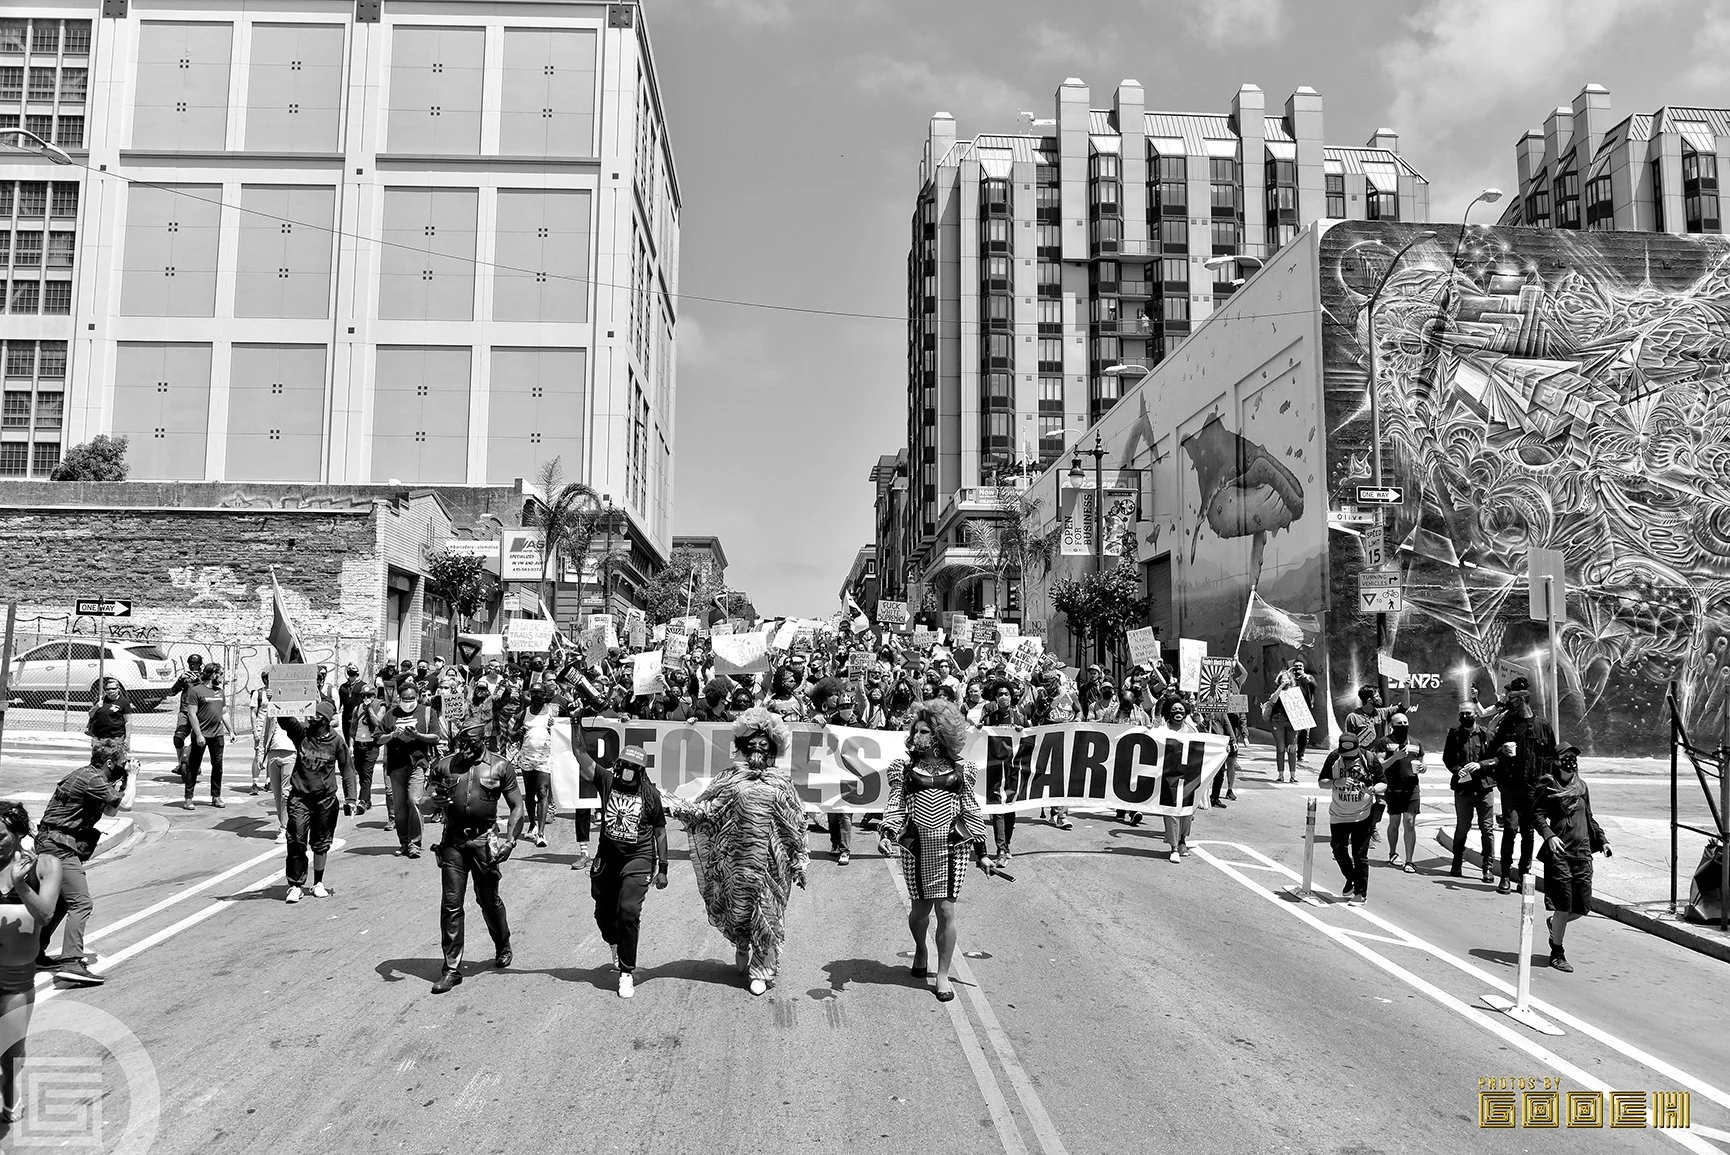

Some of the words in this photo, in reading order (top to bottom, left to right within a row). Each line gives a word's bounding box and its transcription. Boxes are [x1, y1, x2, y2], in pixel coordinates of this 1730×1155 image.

[1084, 494, 1092, 546] BUSINESS
[1065, 516, 1073, 545] OPEN
[1366, 529, 1382, 539] SPEED
[1368, 540, 1380, 548] LIMIT
[1369, 548, 1381, 564] 15
[1032, 620, 1042, 629] NO
[986, 730, 1206, 807] MARCH
